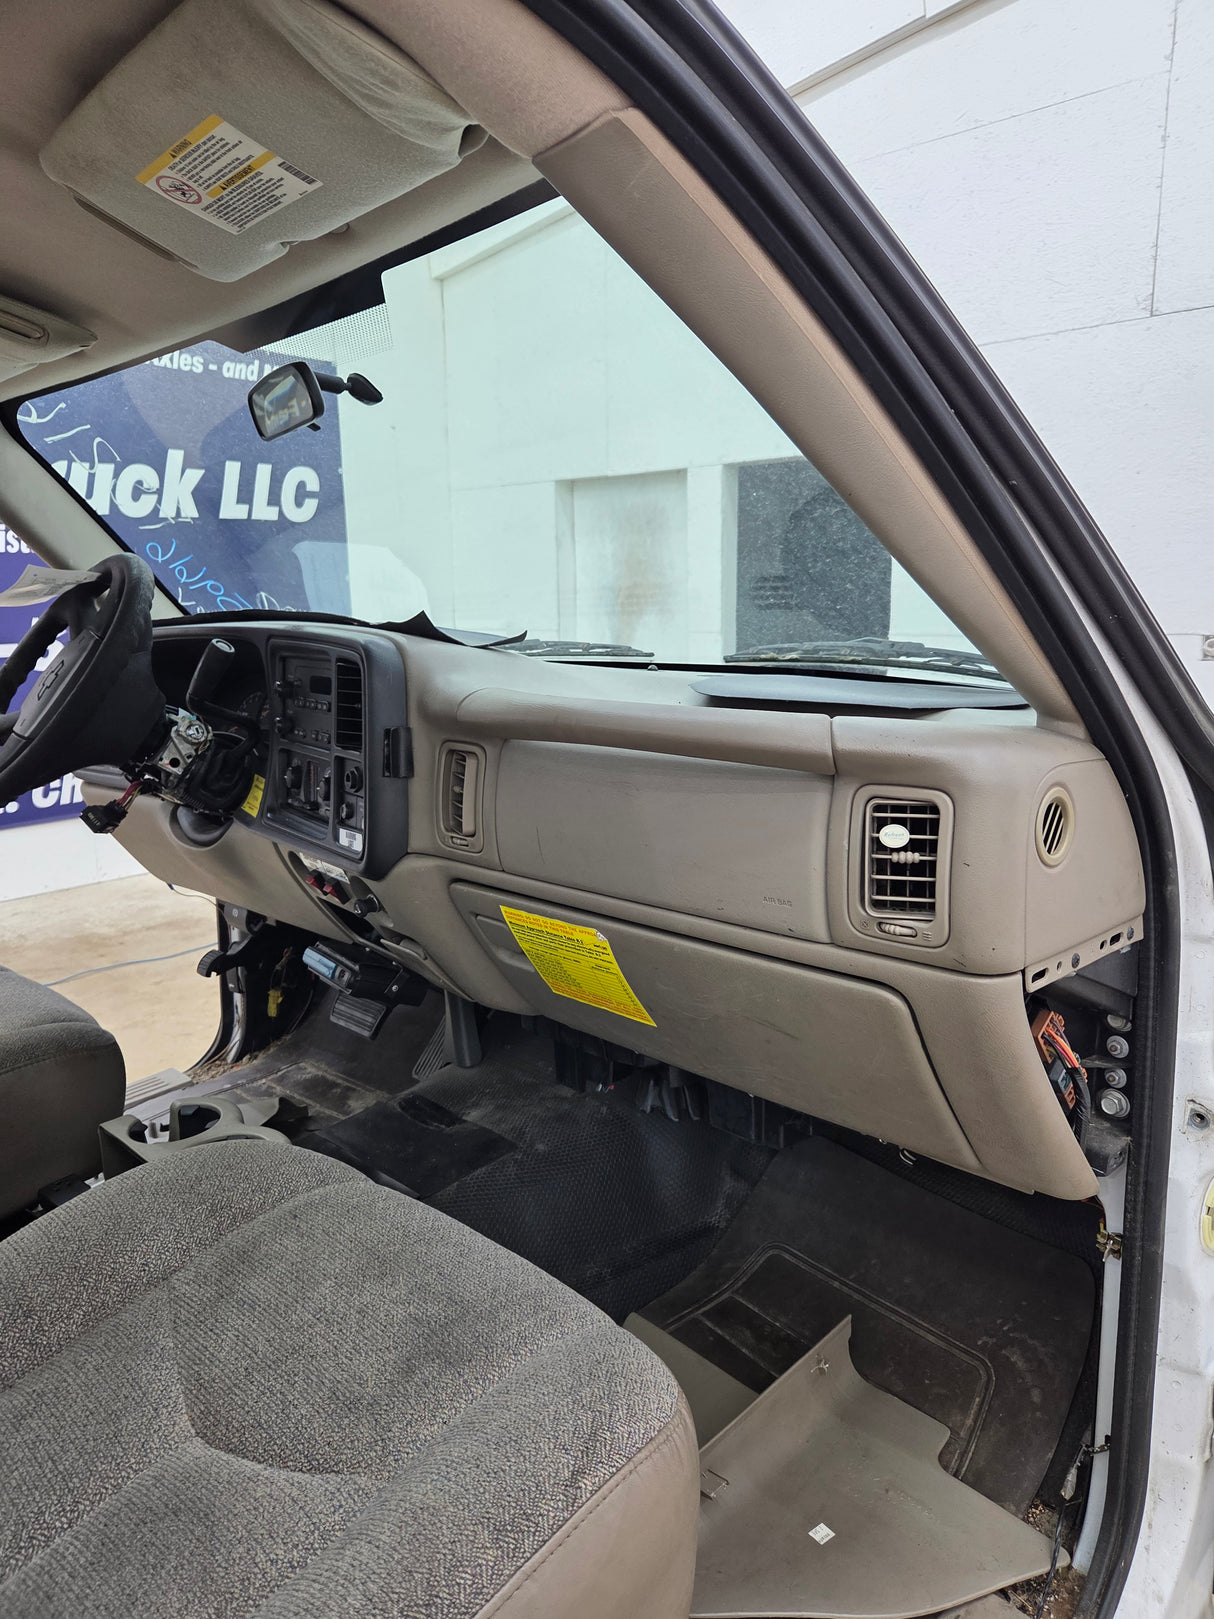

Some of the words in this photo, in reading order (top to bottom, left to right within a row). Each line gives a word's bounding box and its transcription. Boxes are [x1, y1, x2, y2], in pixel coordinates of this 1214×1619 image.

[145, 350, 204, 374] xles
[222, 360, 259, 381] and
[219, 460, 320, 523] LLC
